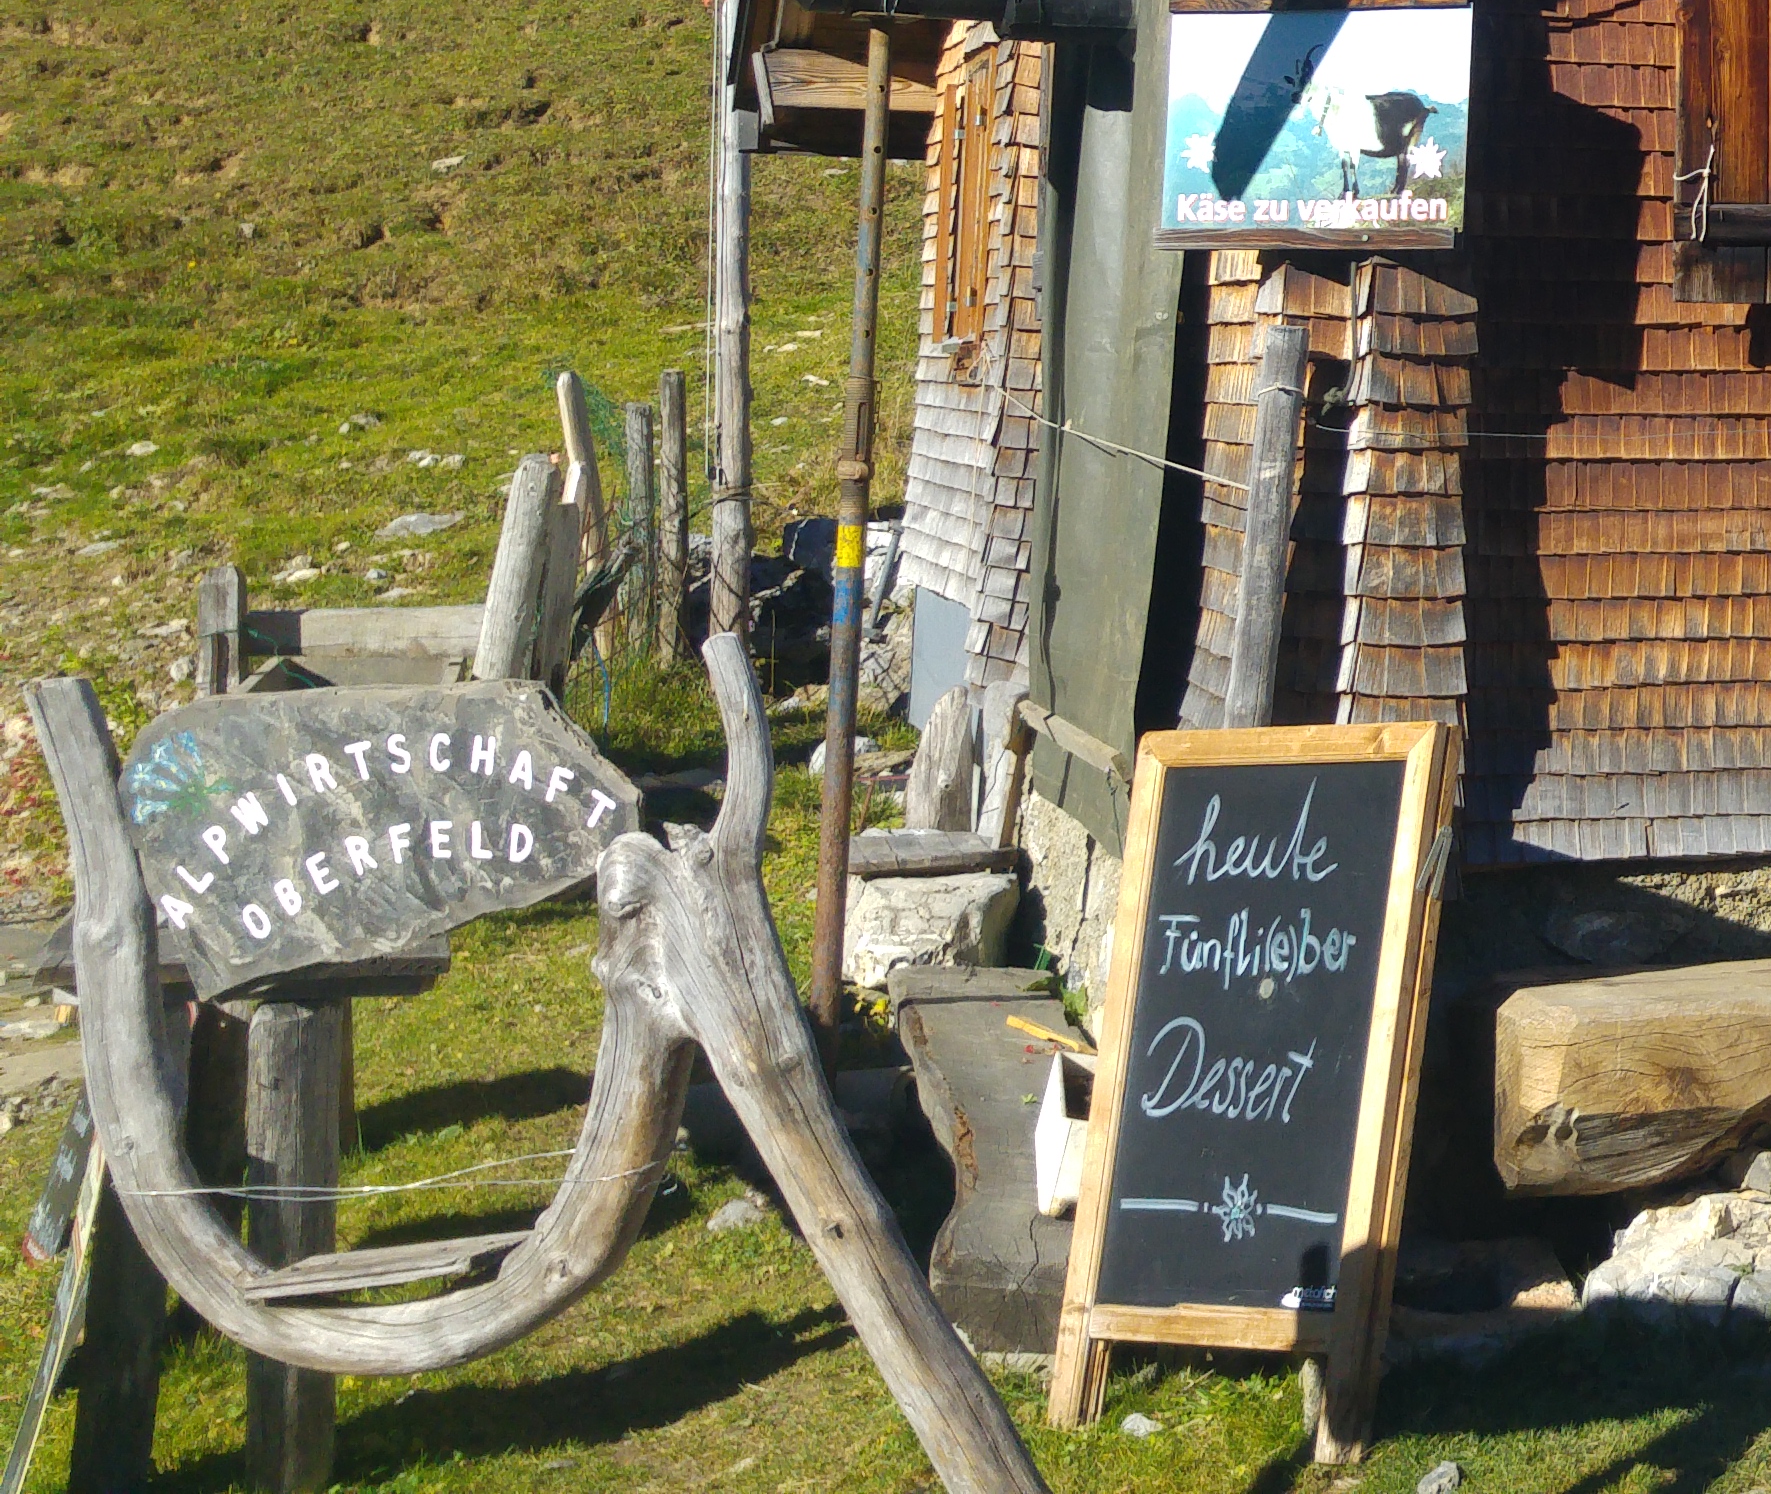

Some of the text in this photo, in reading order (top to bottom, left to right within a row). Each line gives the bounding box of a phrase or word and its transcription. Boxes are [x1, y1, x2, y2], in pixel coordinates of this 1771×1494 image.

[1176, 189, 1448, 223] Käse zu verkaufen
[159, 732, 617, 930] ALPWIRTSCHAFT
[241, 820, 534, 940] OBERFELD
[1173, 775, 1339, 886] heute
[1140, 1015, 1318, 1124] Dessert
